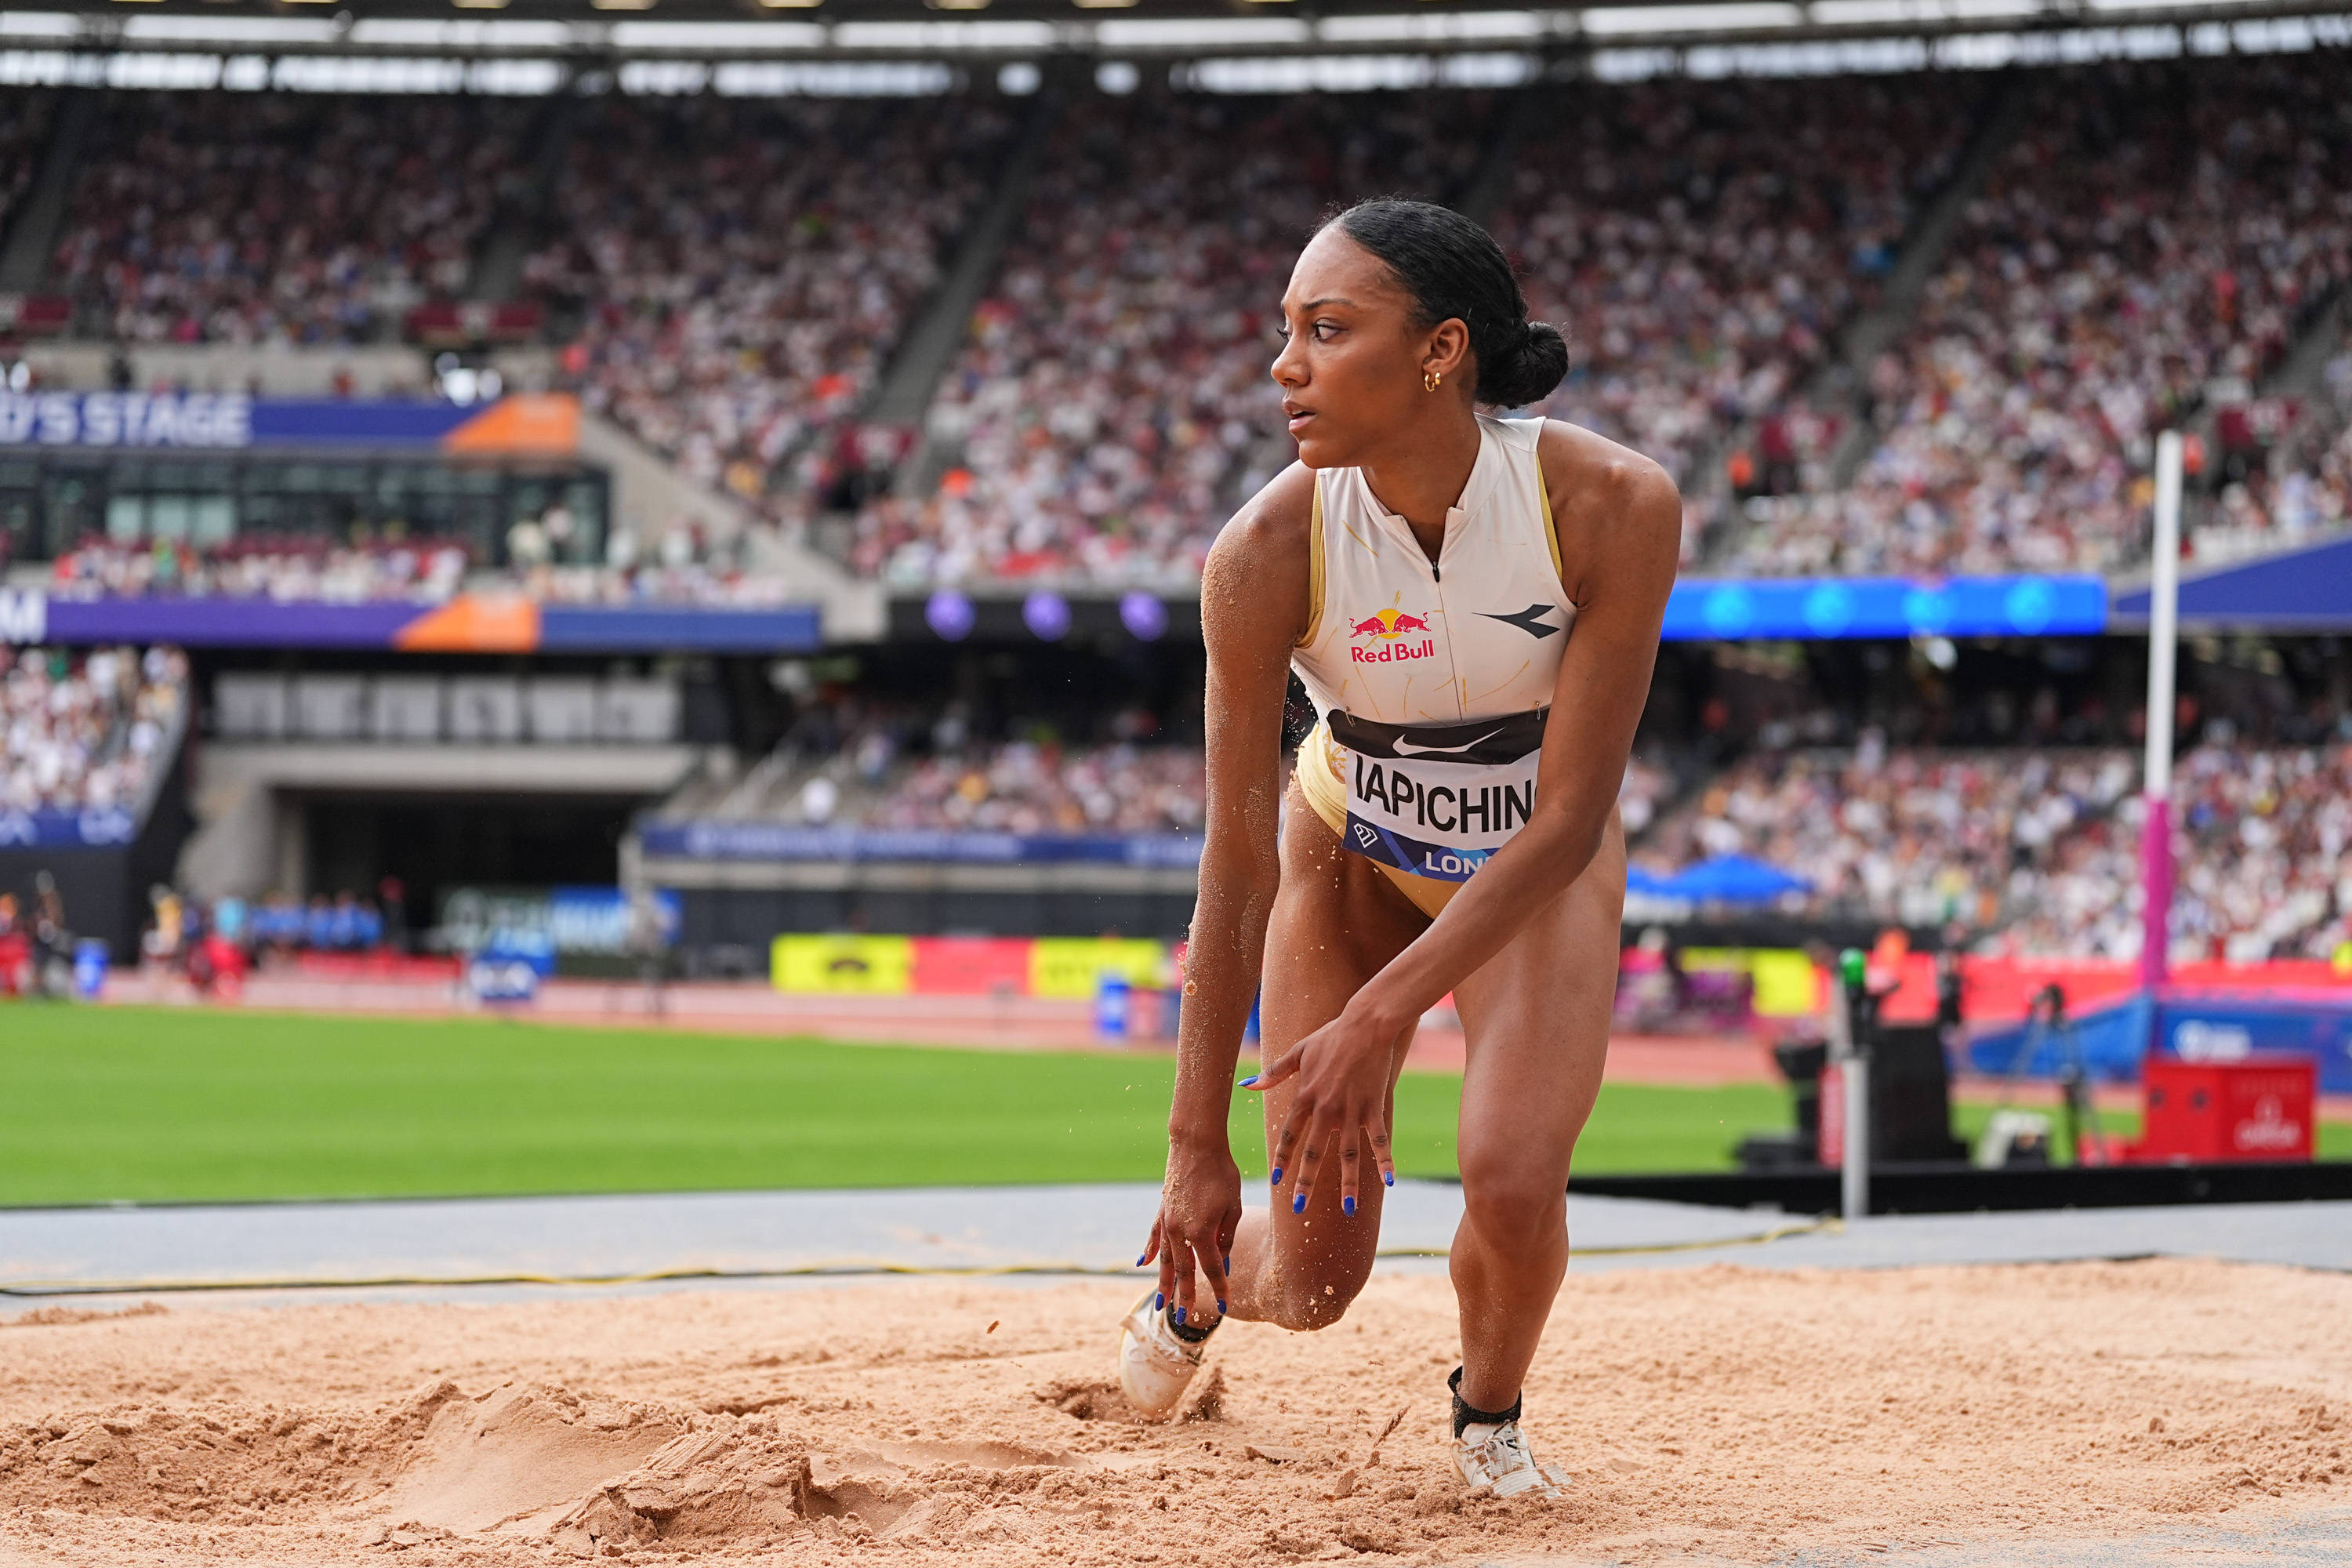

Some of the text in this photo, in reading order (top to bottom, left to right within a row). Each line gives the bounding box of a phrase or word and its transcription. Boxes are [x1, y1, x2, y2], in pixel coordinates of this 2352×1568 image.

[83, 394, 249, 446] STAGE
[1351, 639, 1434, 662] Red Bull
[1356, 753, 1537, 833] IAPICHIN
[1425, 851, 1492, 875] LON
